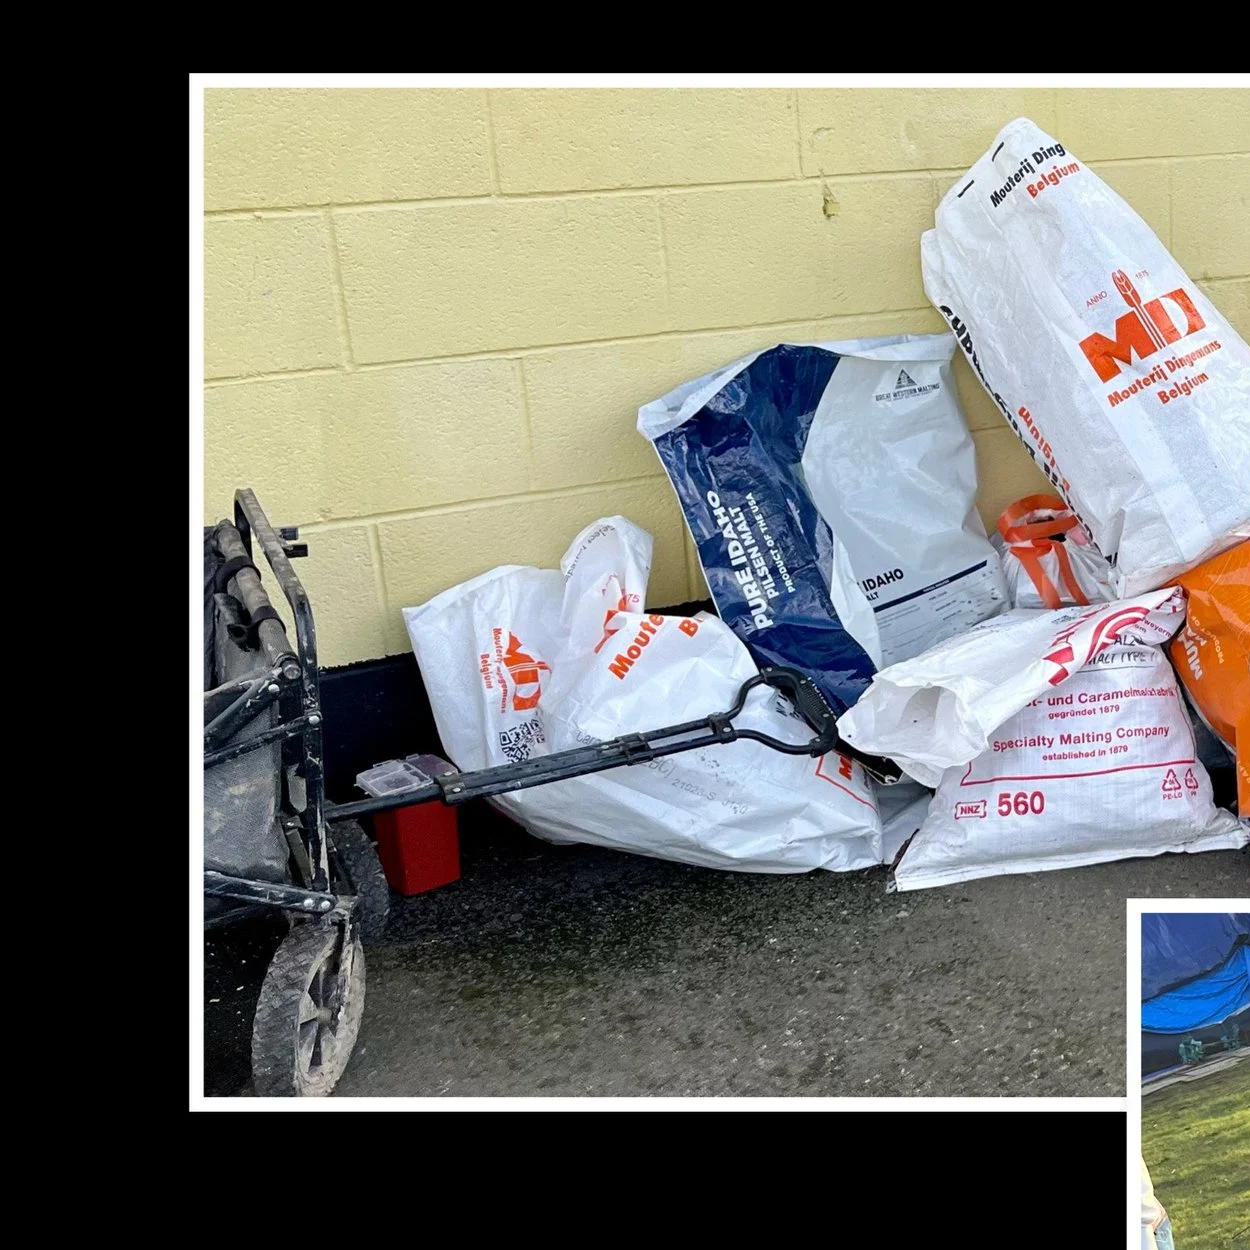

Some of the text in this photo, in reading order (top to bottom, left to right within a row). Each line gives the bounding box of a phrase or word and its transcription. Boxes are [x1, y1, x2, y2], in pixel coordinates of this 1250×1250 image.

[989, 157, 1036, 208] Mouterij
[1026, 162, 1081, 199] Belgium
[1085, 290, 1108, 309] ANNO
[1106, 339, 1223, 408] Mouterij Dingemans
[1156, 371, 1210, 405] Belgium
[875, 392, 892, 402] GREAT
[893, 387, 918, 399] WESTERN
[918, 382, 941, 394] MALTING
[706, 490, 775, 630] PURE IDAHO
[728, 505, 780, 600] PILSEN MALT
[744, 492, 796, 594] PRODUCT OF THE USA
[862, 567, 904, 592] IDAHO
[1199, 626, 1225, 665] PRODUCT
[480, 652, 494, 690] Belgium
[1047, 693, 1074, 707] und
[1047, 703, 1121, 721] gegründet 1879
[992, 724, 1170, 753] Specialty Malting Company
[1041, 744, 1129, 762] established in 1879
[960, 790, 1046, 817] NNZ 560
